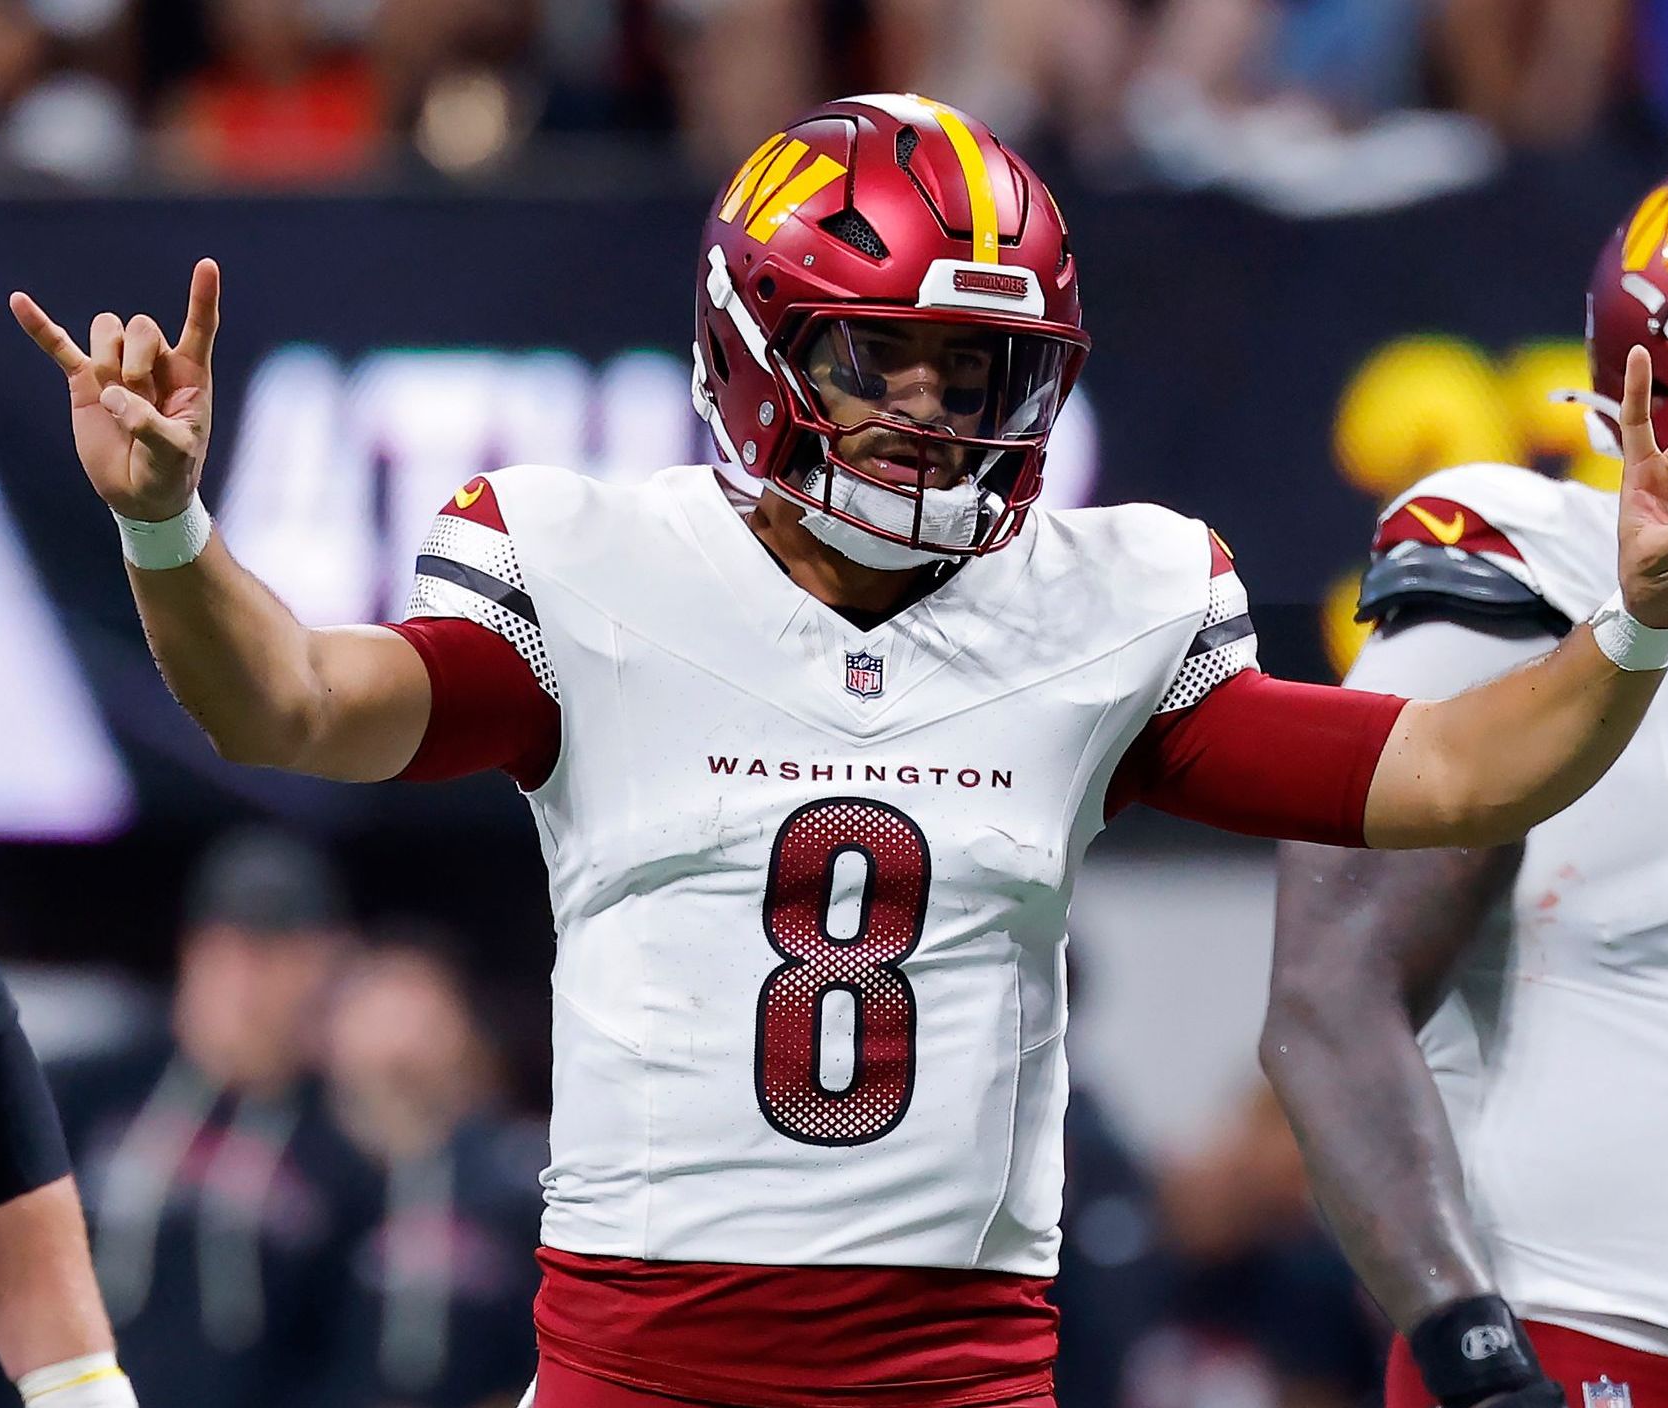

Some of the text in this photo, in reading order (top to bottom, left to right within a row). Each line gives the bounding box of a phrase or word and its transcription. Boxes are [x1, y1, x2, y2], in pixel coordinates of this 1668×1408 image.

[849, 669, 878, 692] NFL
[707, 755, 1015, 790] WASHINGTON
[755, 796, 932, 1147] 8
